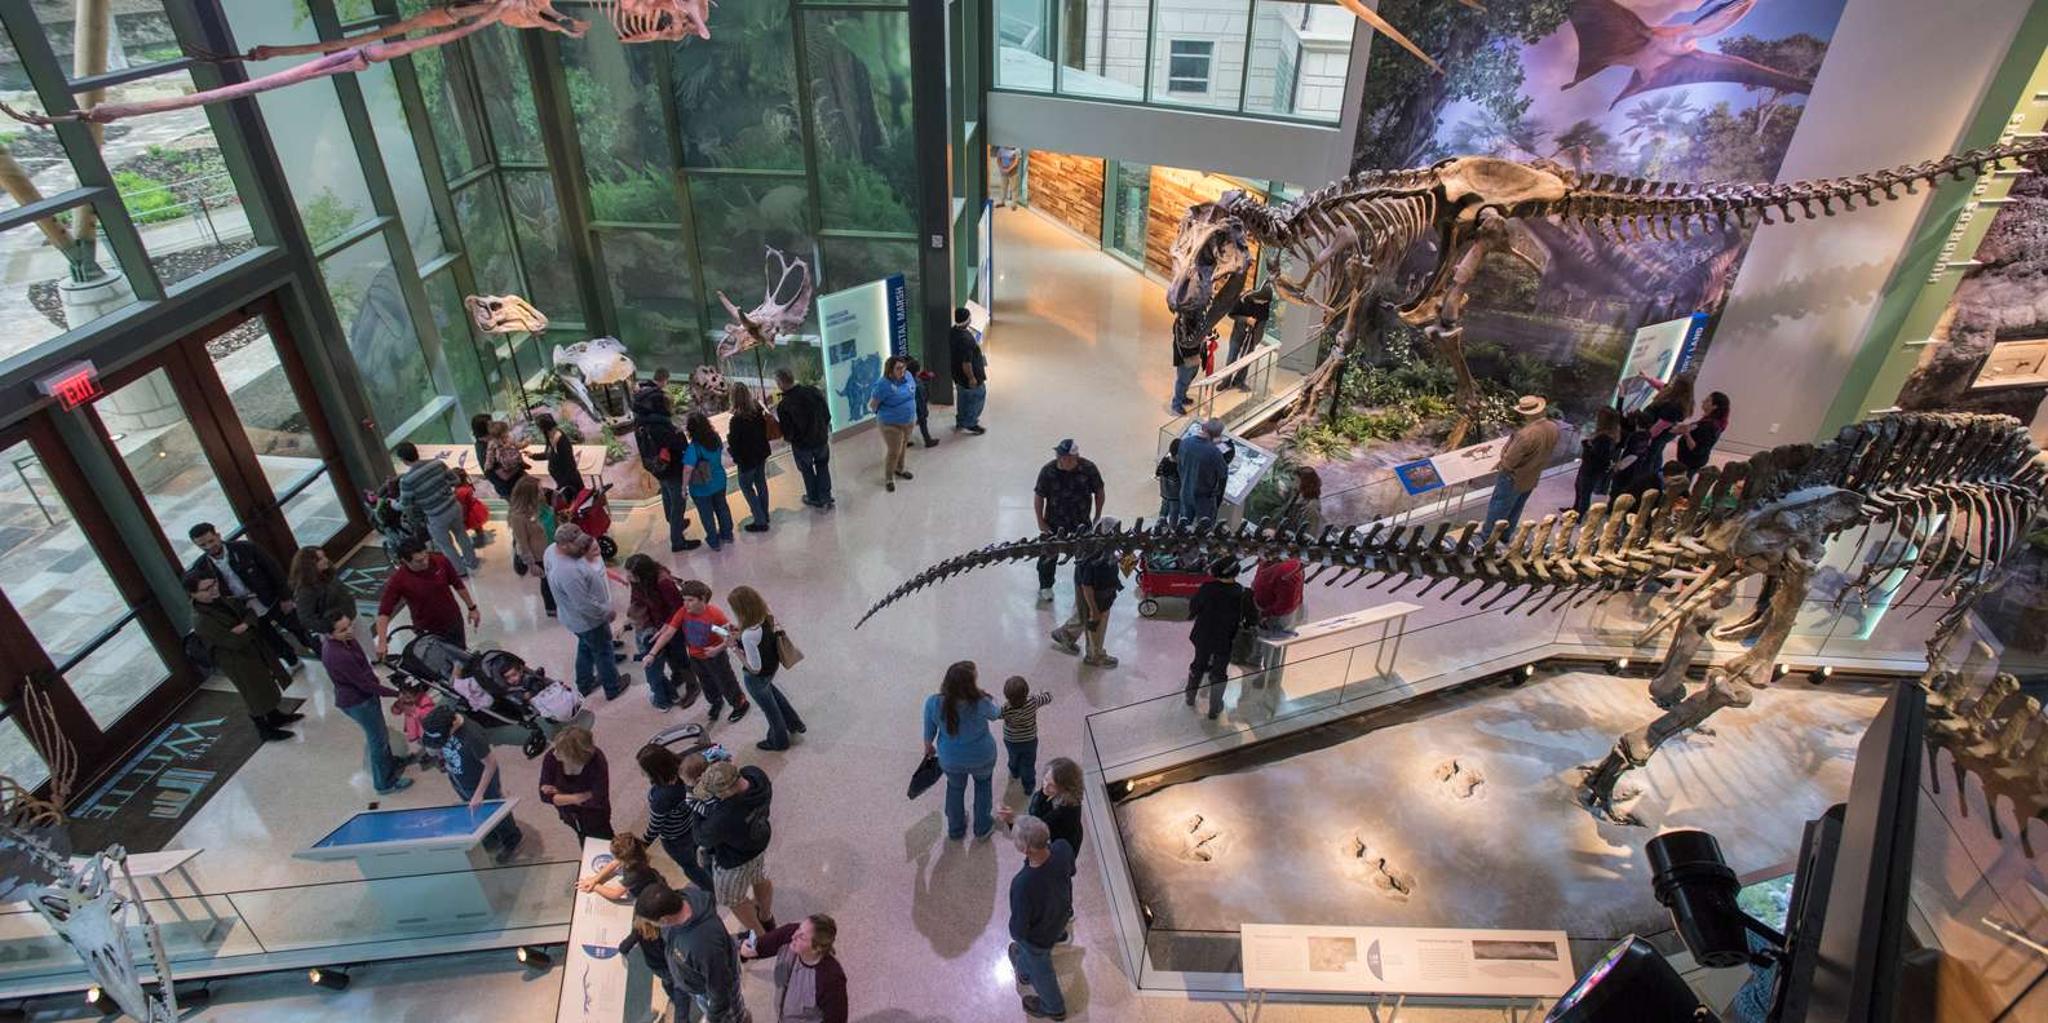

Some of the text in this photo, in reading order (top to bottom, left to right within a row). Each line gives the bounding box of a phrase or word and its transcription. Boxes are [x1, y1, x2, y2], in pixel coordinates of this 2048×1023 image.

[1928, 202, 1979, 284] HUNDREDS
[895, 286, 908, 358] OASTAL MARSH
[63, 375, 95, 405] EXIT
[83, 716, 228, 820] WITTE
